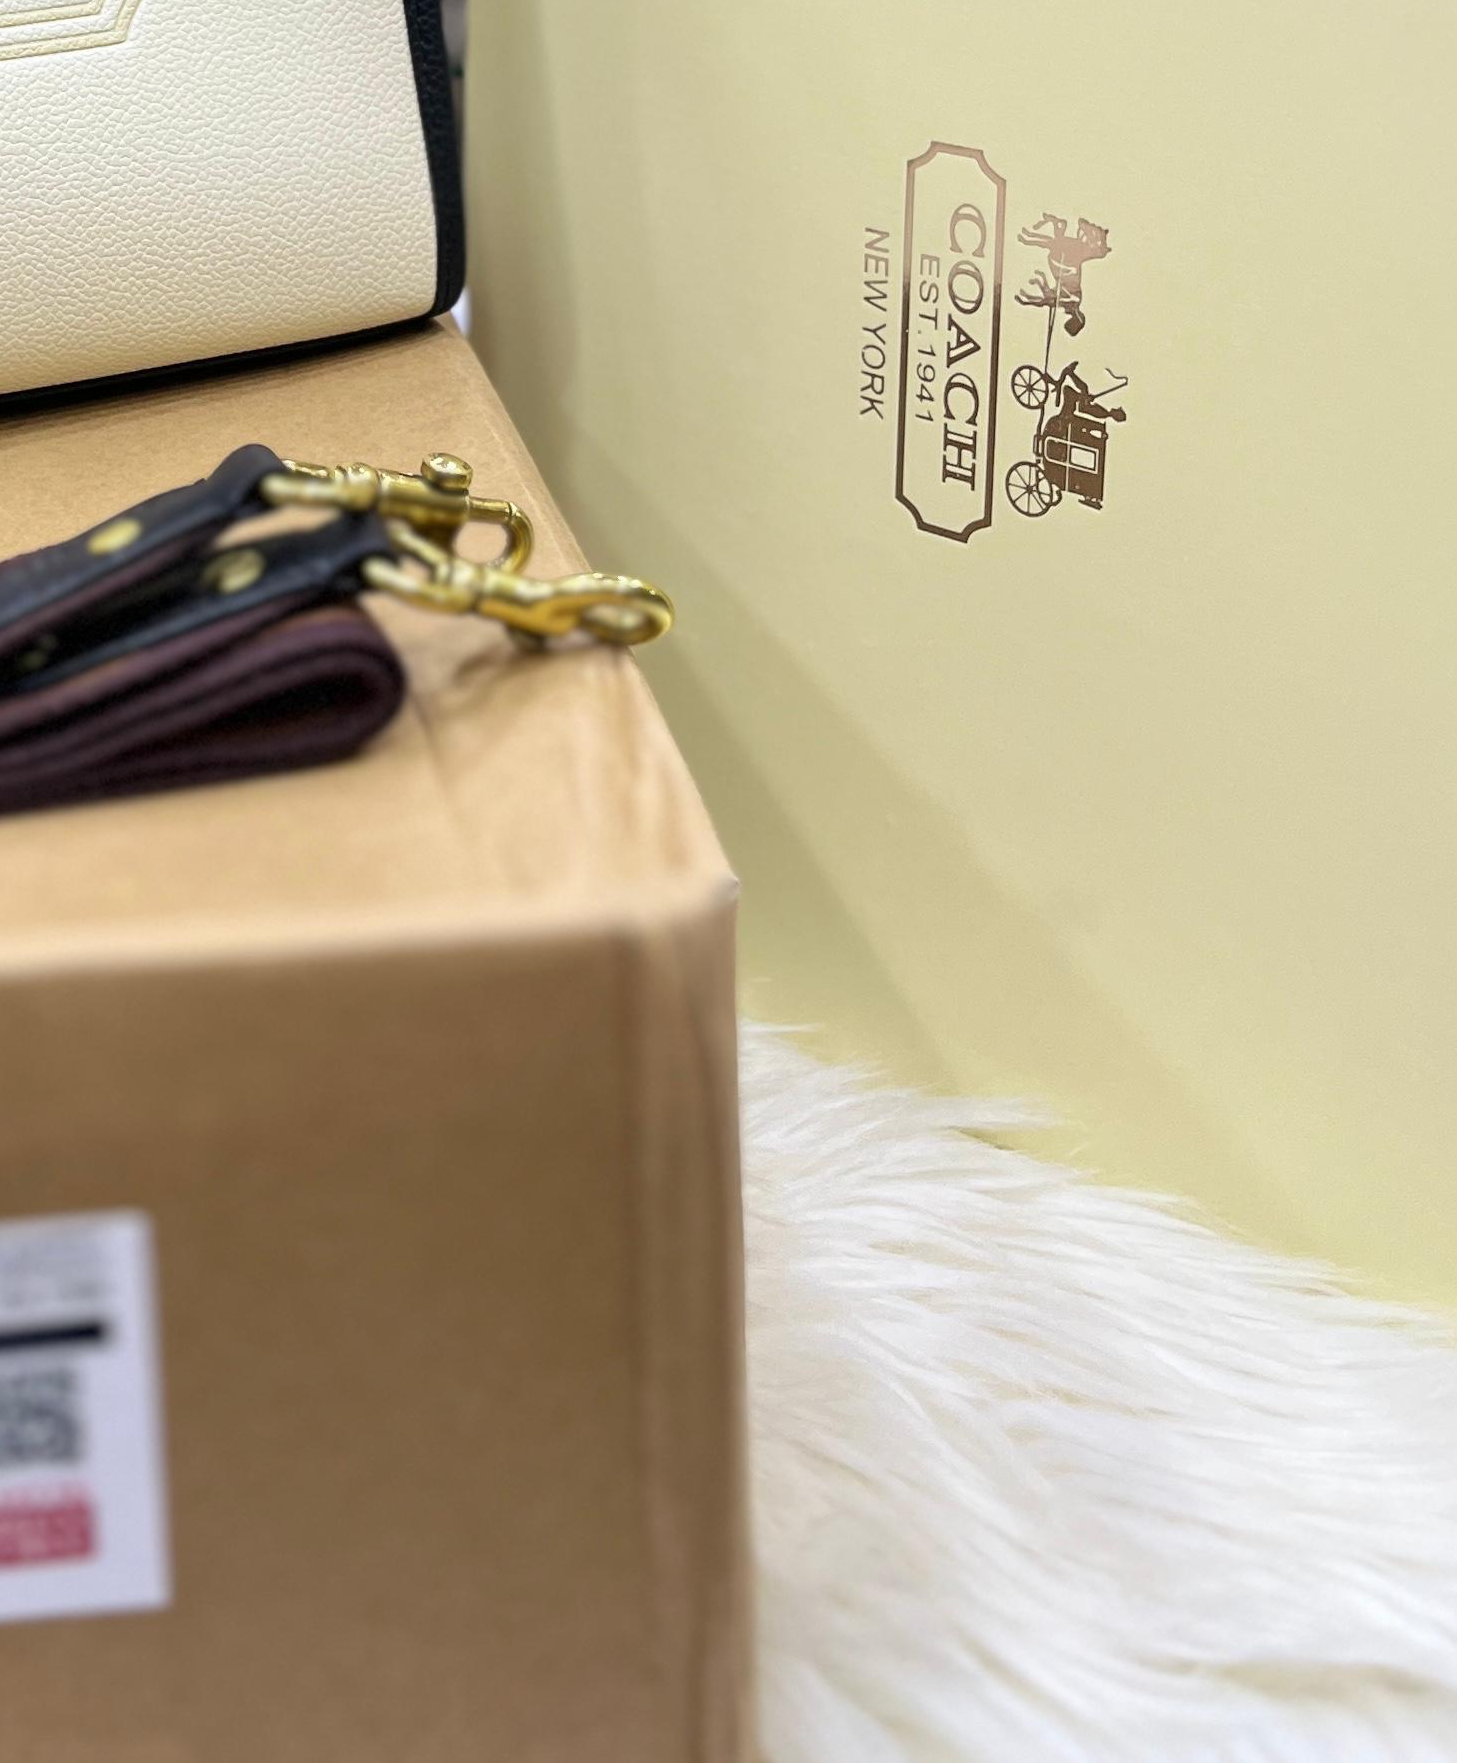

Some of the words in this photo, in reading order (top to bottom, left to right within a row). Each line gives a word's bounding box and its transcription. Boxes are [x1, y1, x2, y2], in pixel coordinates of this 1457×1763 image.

[863, 226, 890, 313] NEW
[917, 252, 941, 335] EST.
[859, 322, 887, 421] YORK
[914, 343, 937, 424] 1941
[942, 202, 987, 492] COACH
